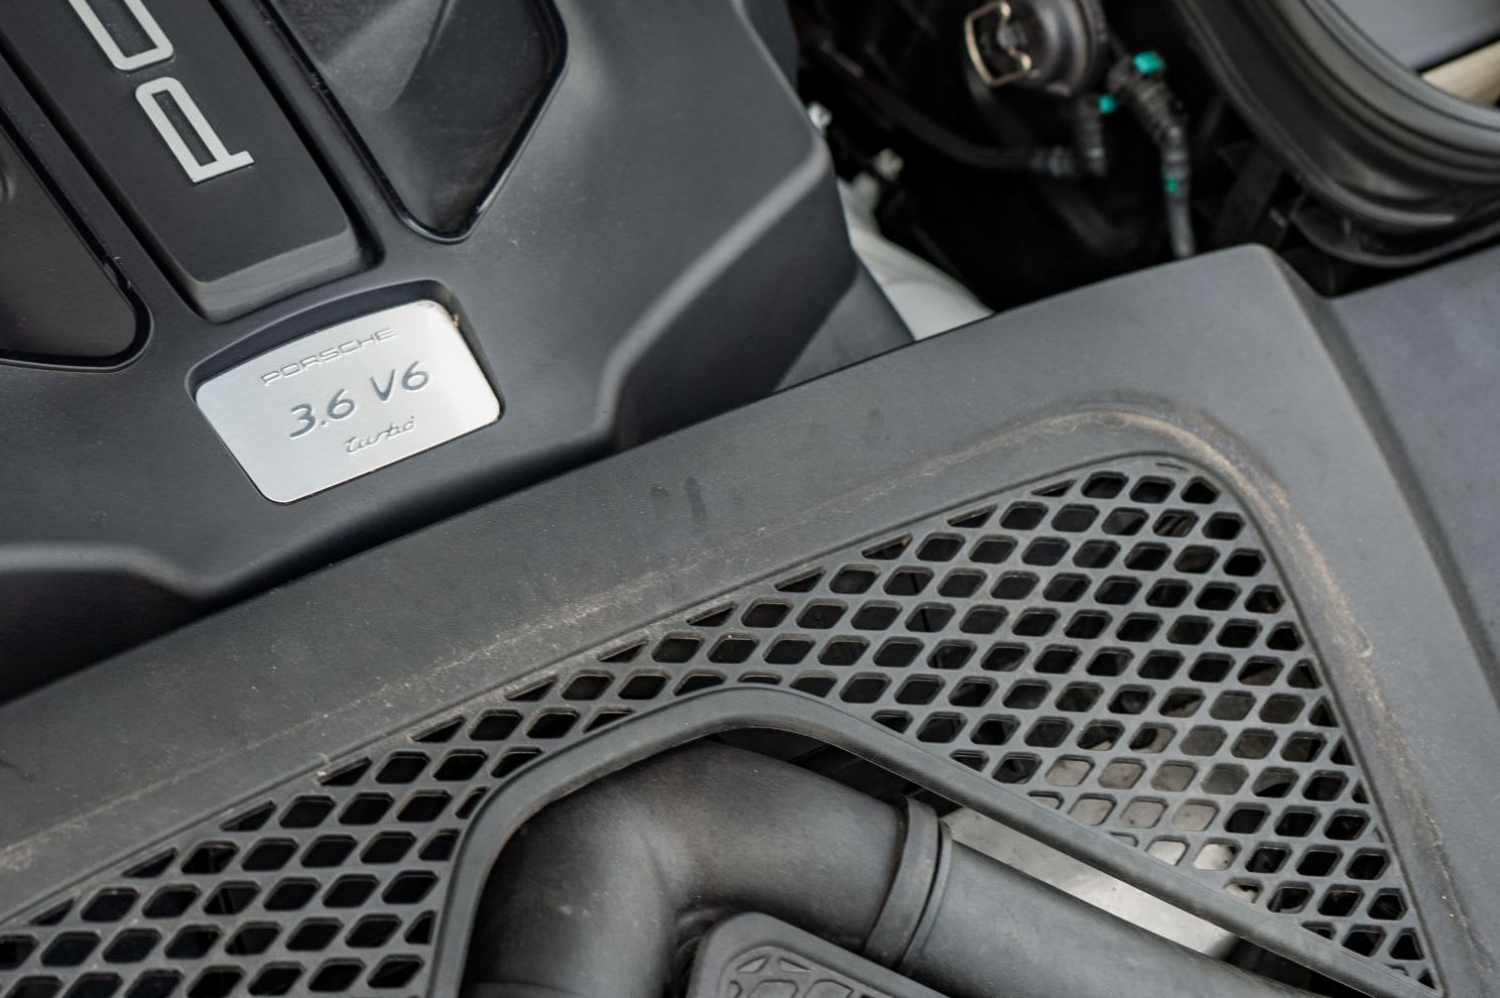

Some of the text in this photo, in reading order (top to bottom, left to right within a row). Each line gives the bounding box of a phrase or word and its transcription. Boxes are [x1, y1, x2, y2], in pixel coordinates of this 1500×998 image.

[260, 327, 396, 386] PORSCHE
[289, 361, 430, 438] 3.6 V6
[345, 415, 417, 453] turbo
